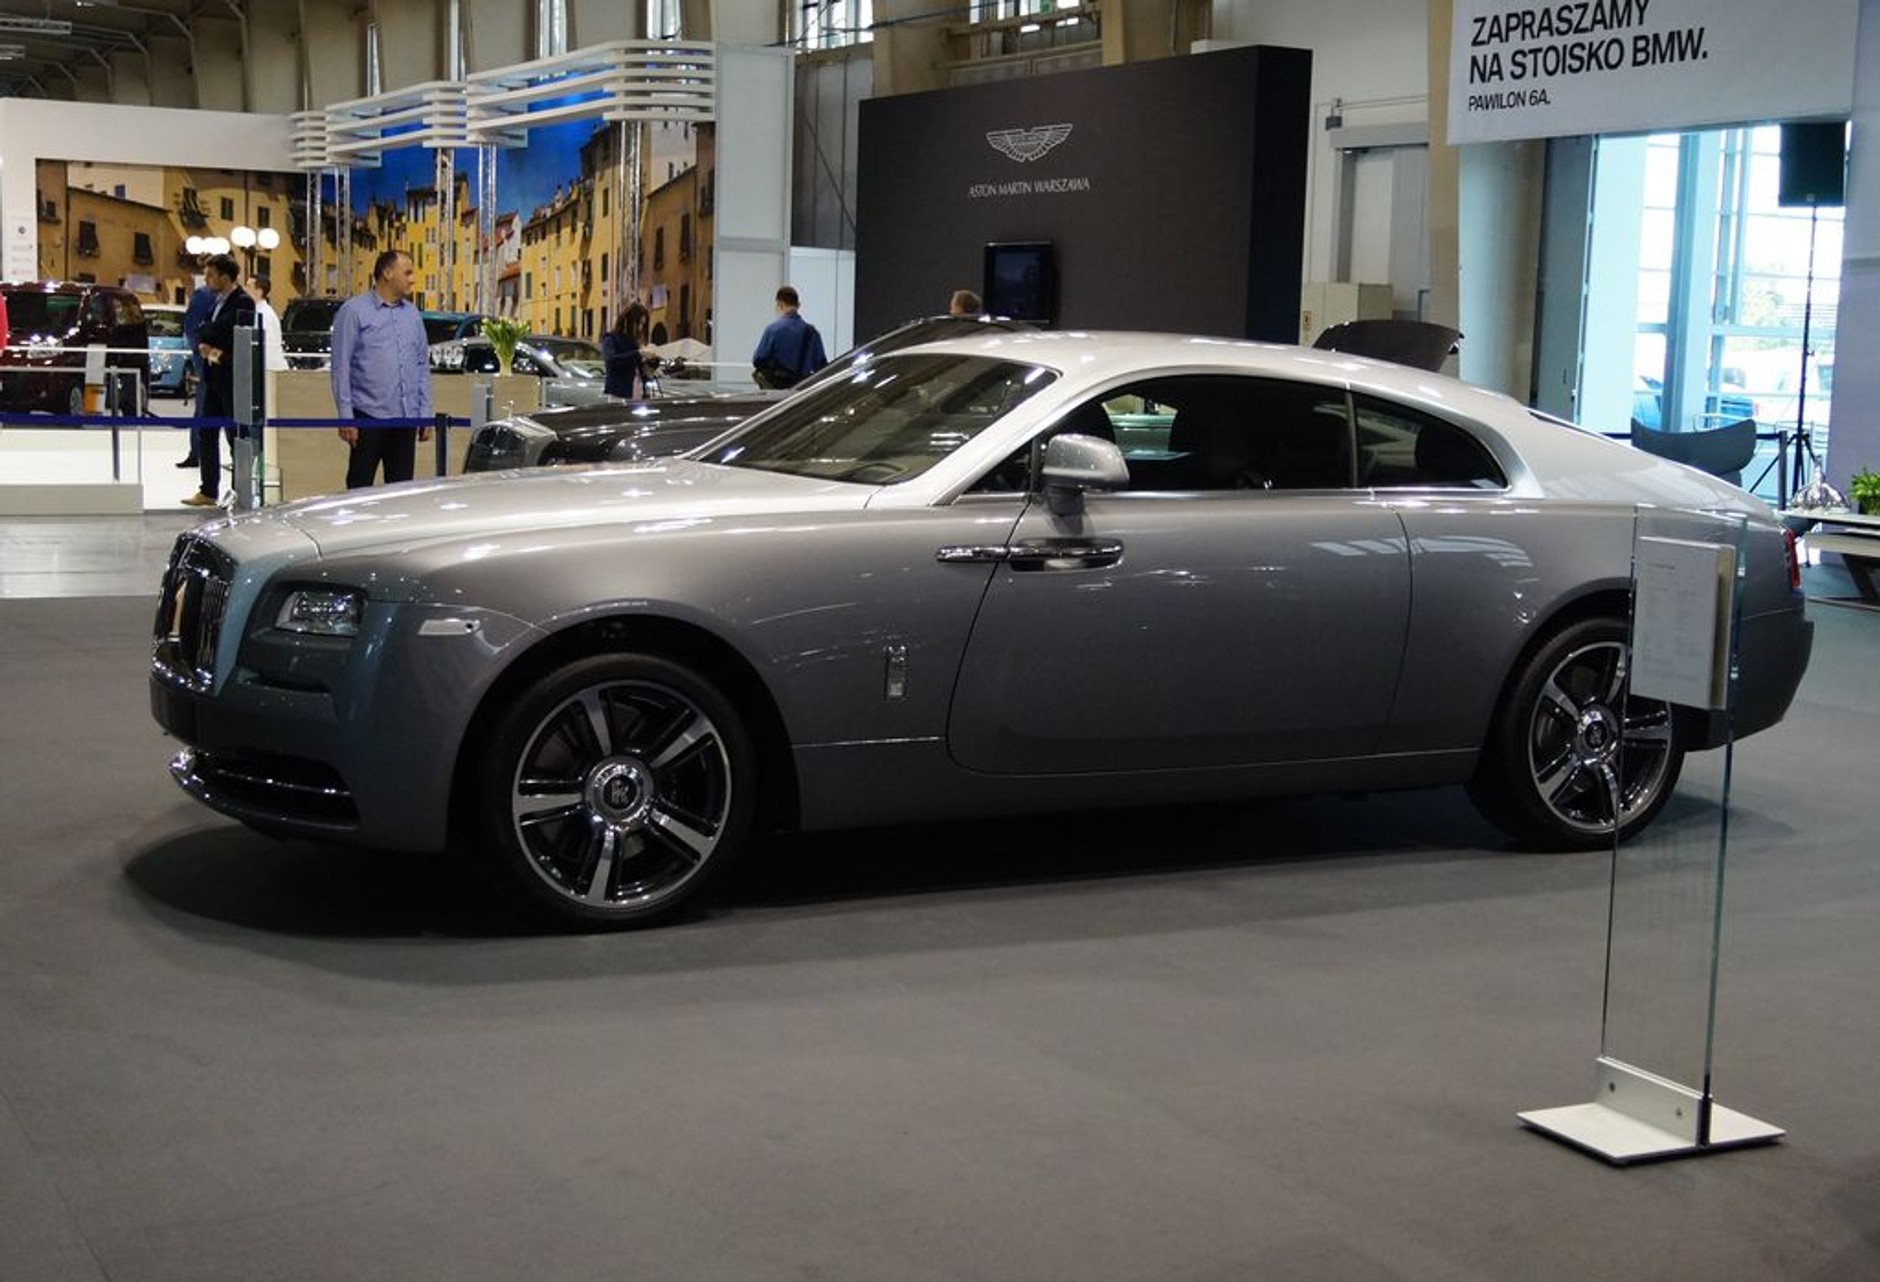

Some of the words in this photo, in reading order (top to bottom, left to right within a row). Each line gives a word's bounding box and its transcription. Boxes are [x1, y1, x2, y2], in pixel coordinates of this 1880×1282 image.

[1471, 0, 1649, 47] ZAPRASZAMY
[1469, 53, 1504, 84] NA
[1510, 38, 1624, 80] STOISKO
[1632, 27, 1708, 67] BMW.
[1468, 90, 1526, 111] PAWILON
[1529, 88, 1550, 106] 6A.
[969, 184, 996, 198] ASTON
[999, 181, 1031, 196] MARTIN
[1034, 178, 1090, 192] WARSZAWA
